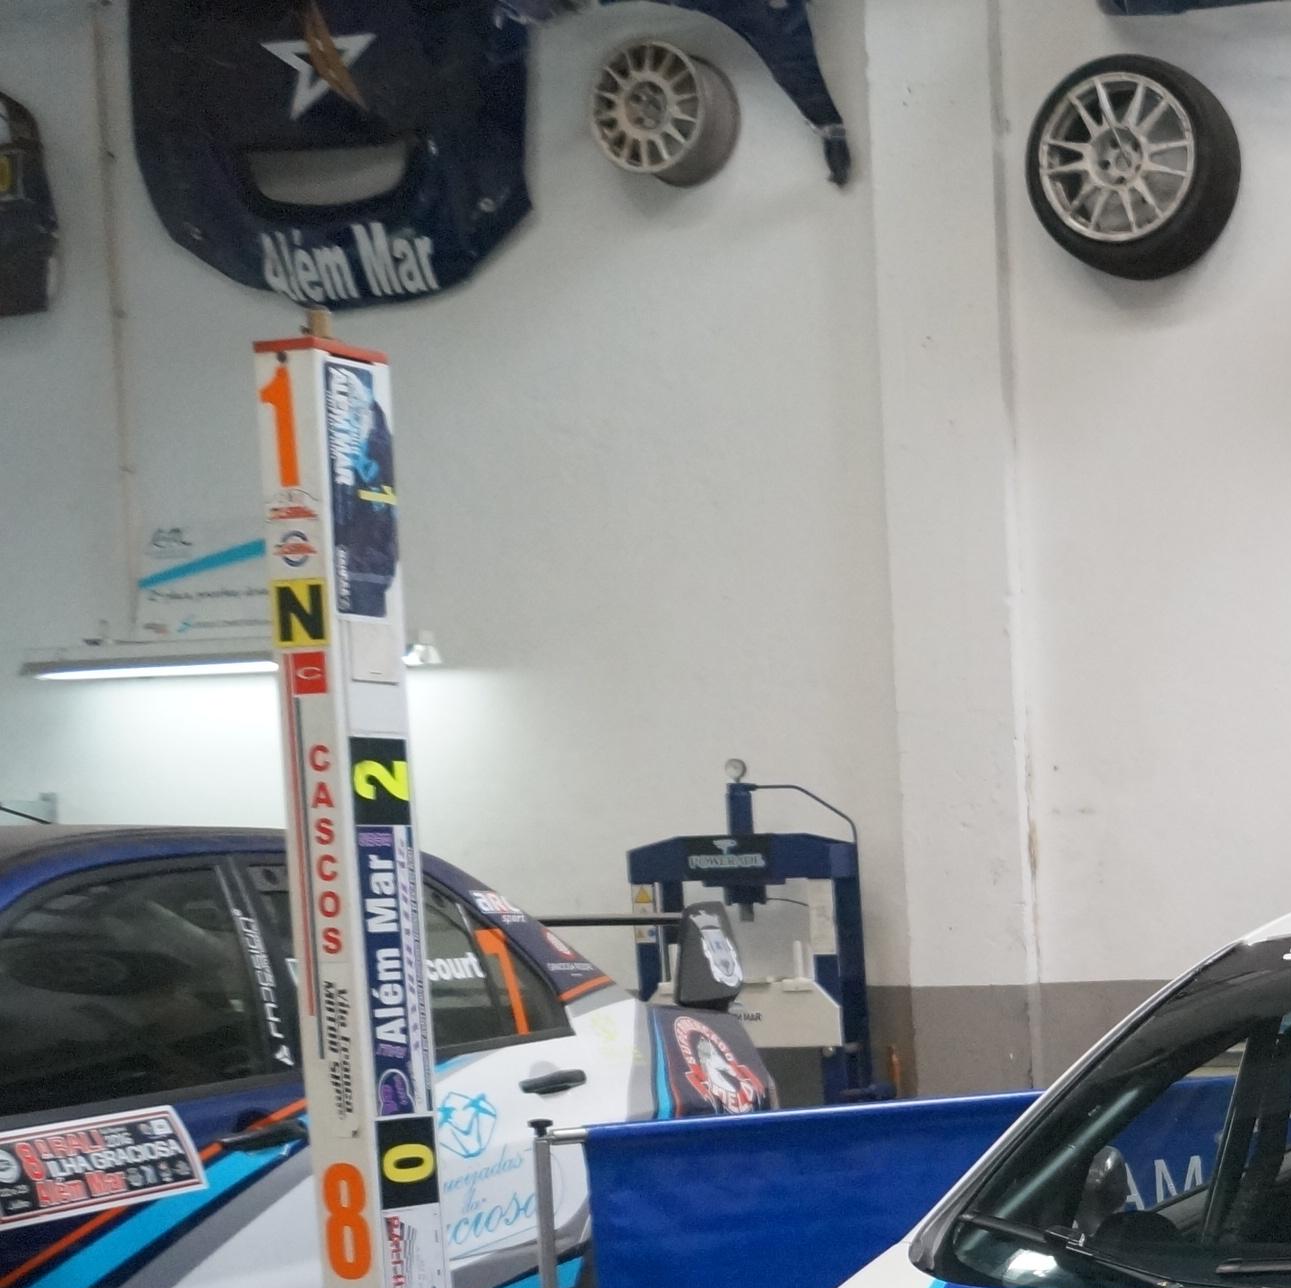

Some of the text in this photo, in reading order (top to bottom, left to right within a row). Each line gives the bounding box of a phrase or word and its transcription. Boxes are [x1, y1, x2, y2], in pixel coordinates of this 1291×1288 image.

[261, 222, 440, 301] Além Mar
[260, 366, 300, 487] 1
[276, 584, 325, 642] N
[353, 759, 410, 801] 2
[308, 744, 344, 955] CASCOS
[366, 854, 400, 934] Mar
[374, 947, 409, 1047] Além
[323, 1162, 372, 1281] 8
